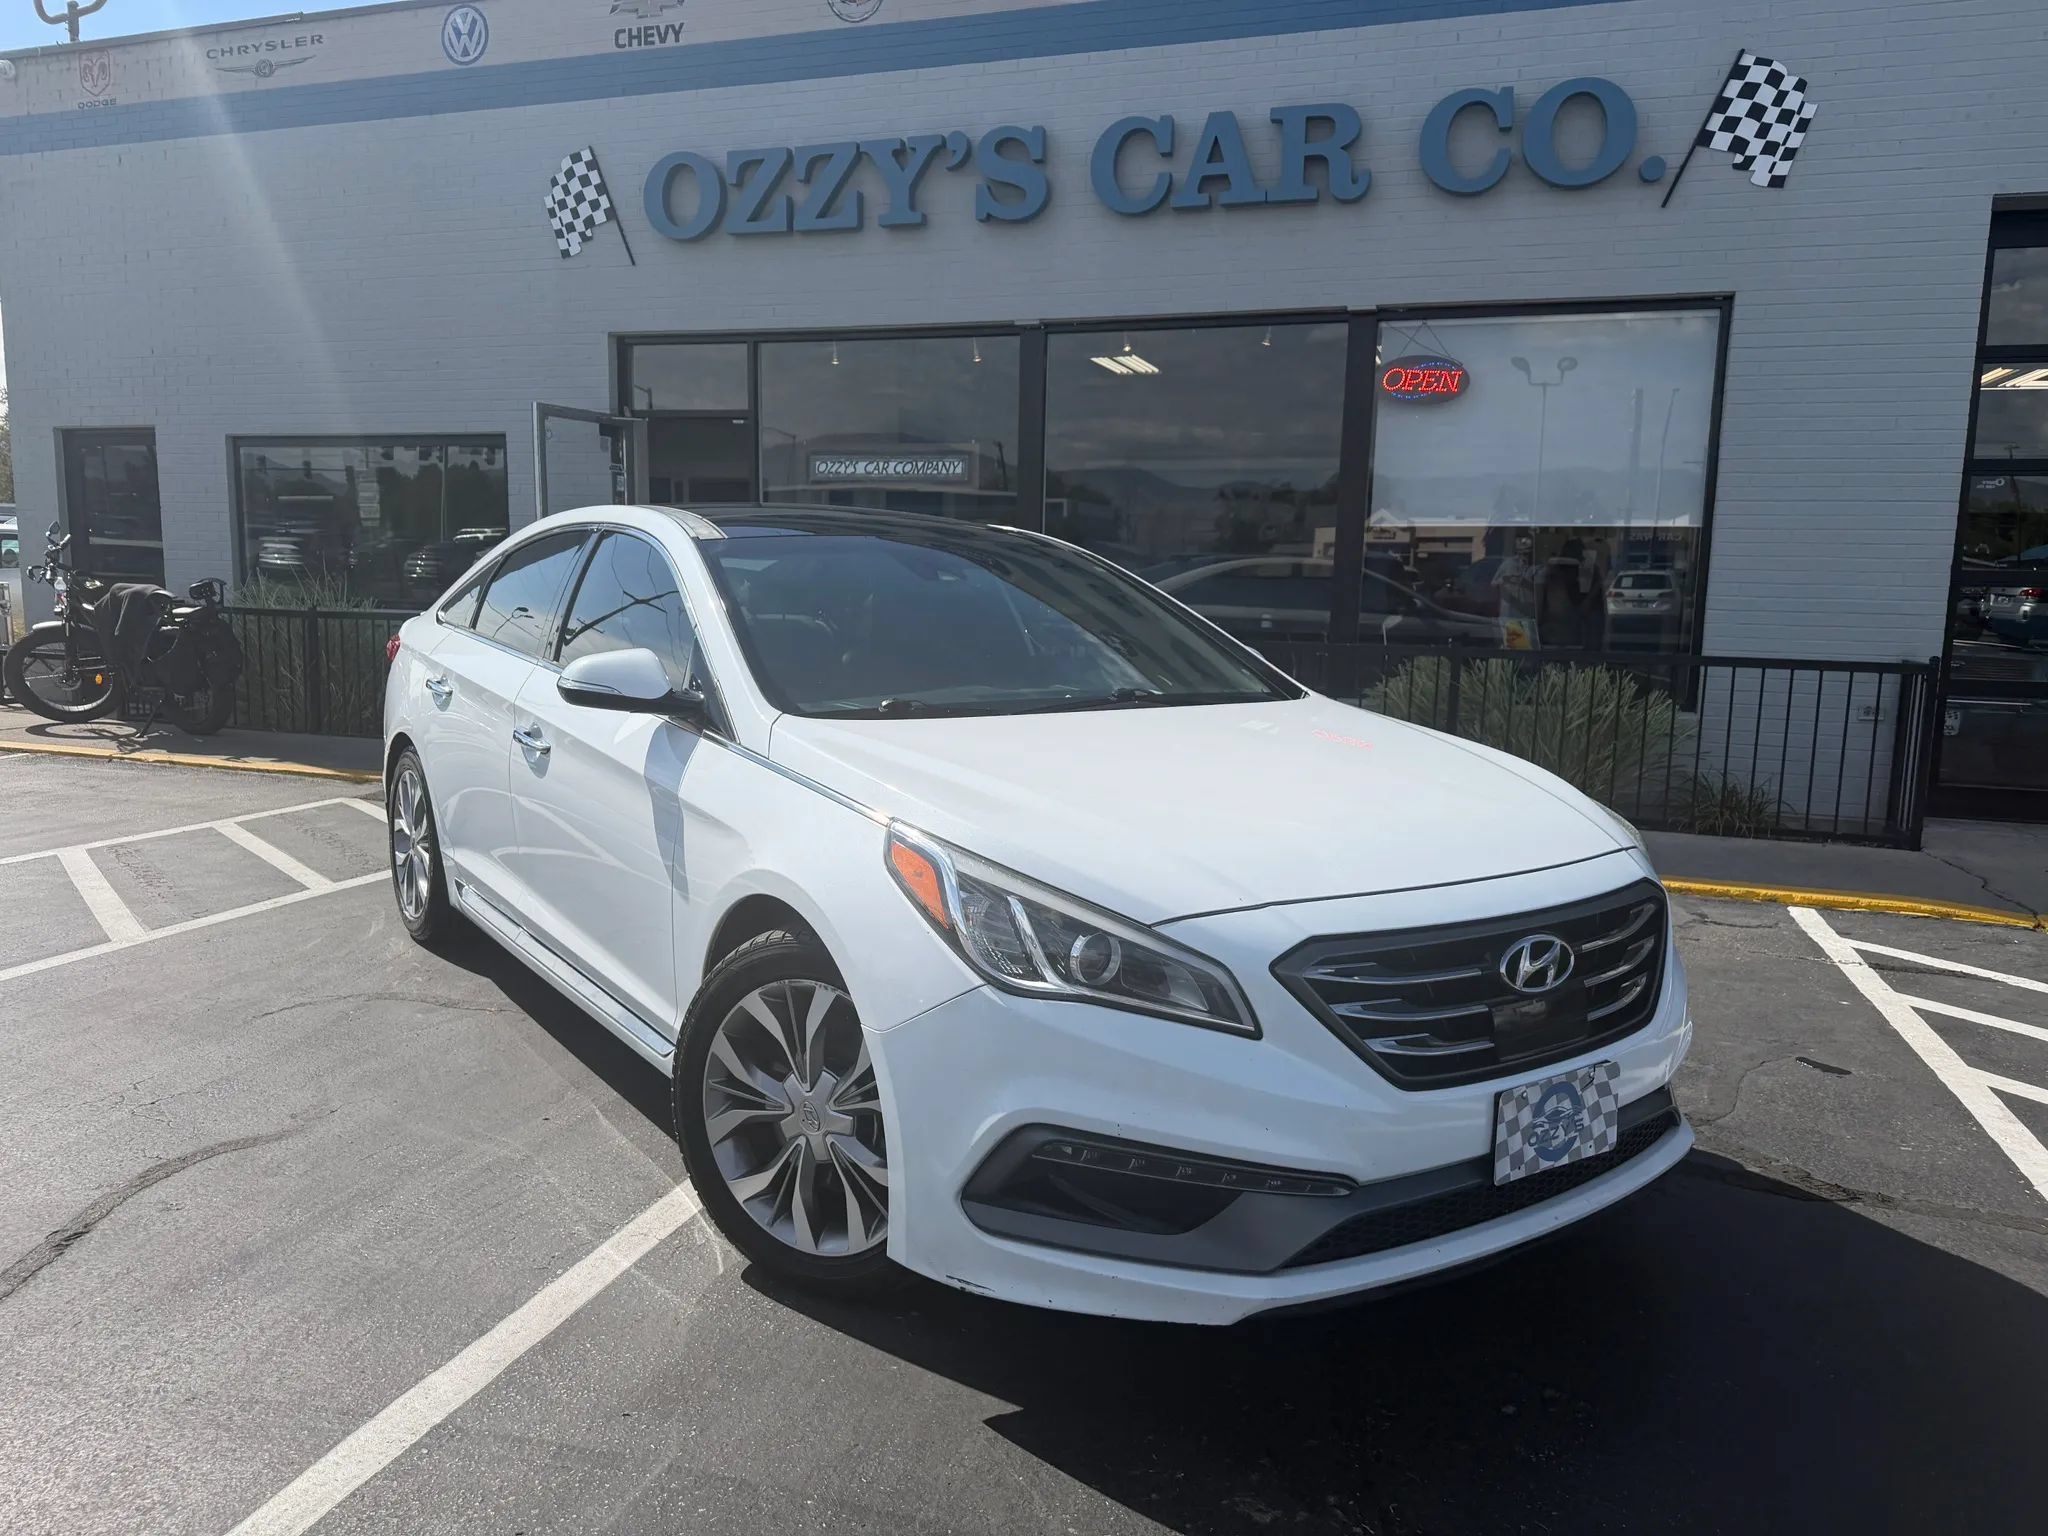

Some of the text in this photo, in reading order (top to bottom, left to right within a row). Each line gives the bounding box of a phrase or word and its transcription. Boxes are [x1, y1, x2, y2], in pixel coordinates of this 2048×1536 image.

[206, 34, 324, 59] CHRYSLER
[614, 22, 685, 49] CHEVY
[78, 98, 117, 109] DODGE
[643, 76, 1667, 241] OZZY'S CAR CO.
[1382, 367, 1463, 392] OPEN
[816, 460, 961, 475] OZZY'S CAR COMPANY
